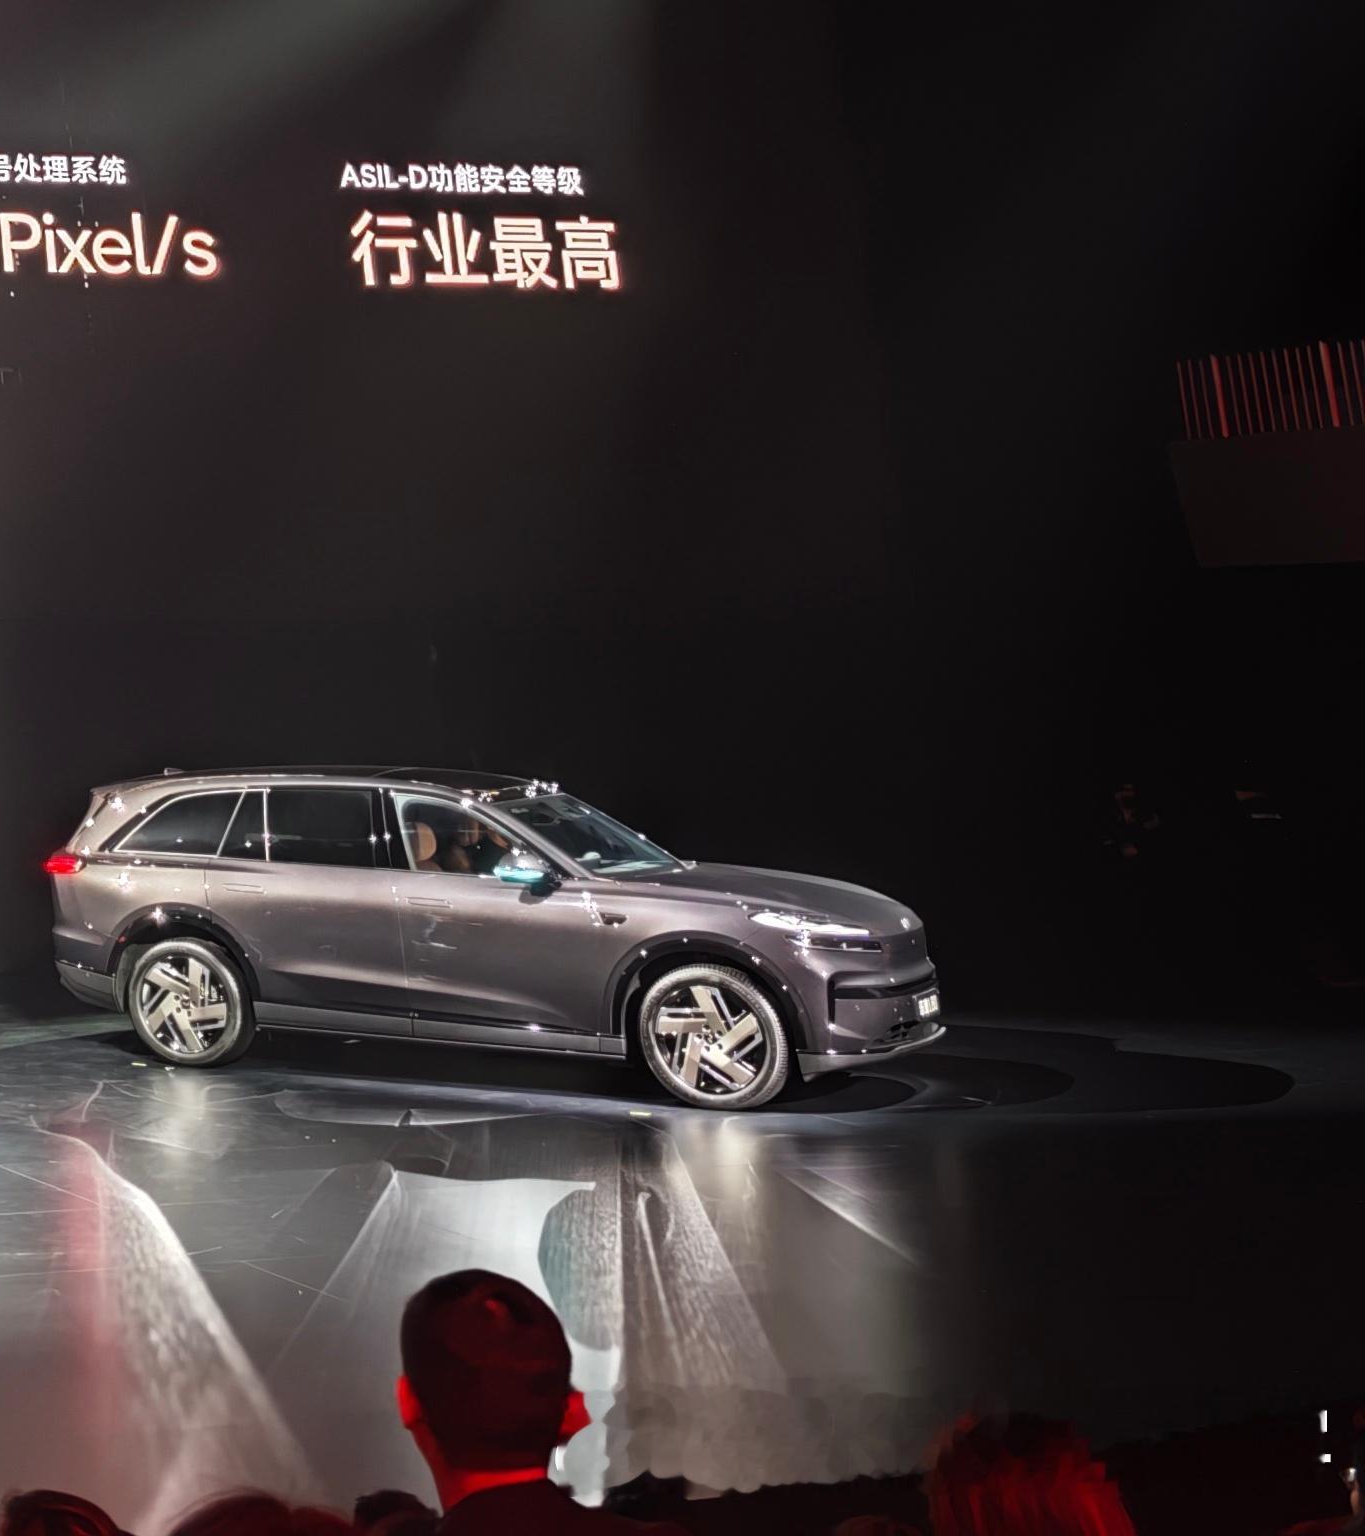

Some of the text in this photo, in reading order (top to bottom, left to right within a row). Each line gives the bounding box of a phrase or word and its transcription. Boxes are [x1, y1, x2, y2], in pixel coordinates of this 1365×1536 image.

[339, 162, 585, 197] ASIL-D功能安全等级
[0, 212, 218, 277] Pixel/s
[350, 210, 621, 290] 行业最高
